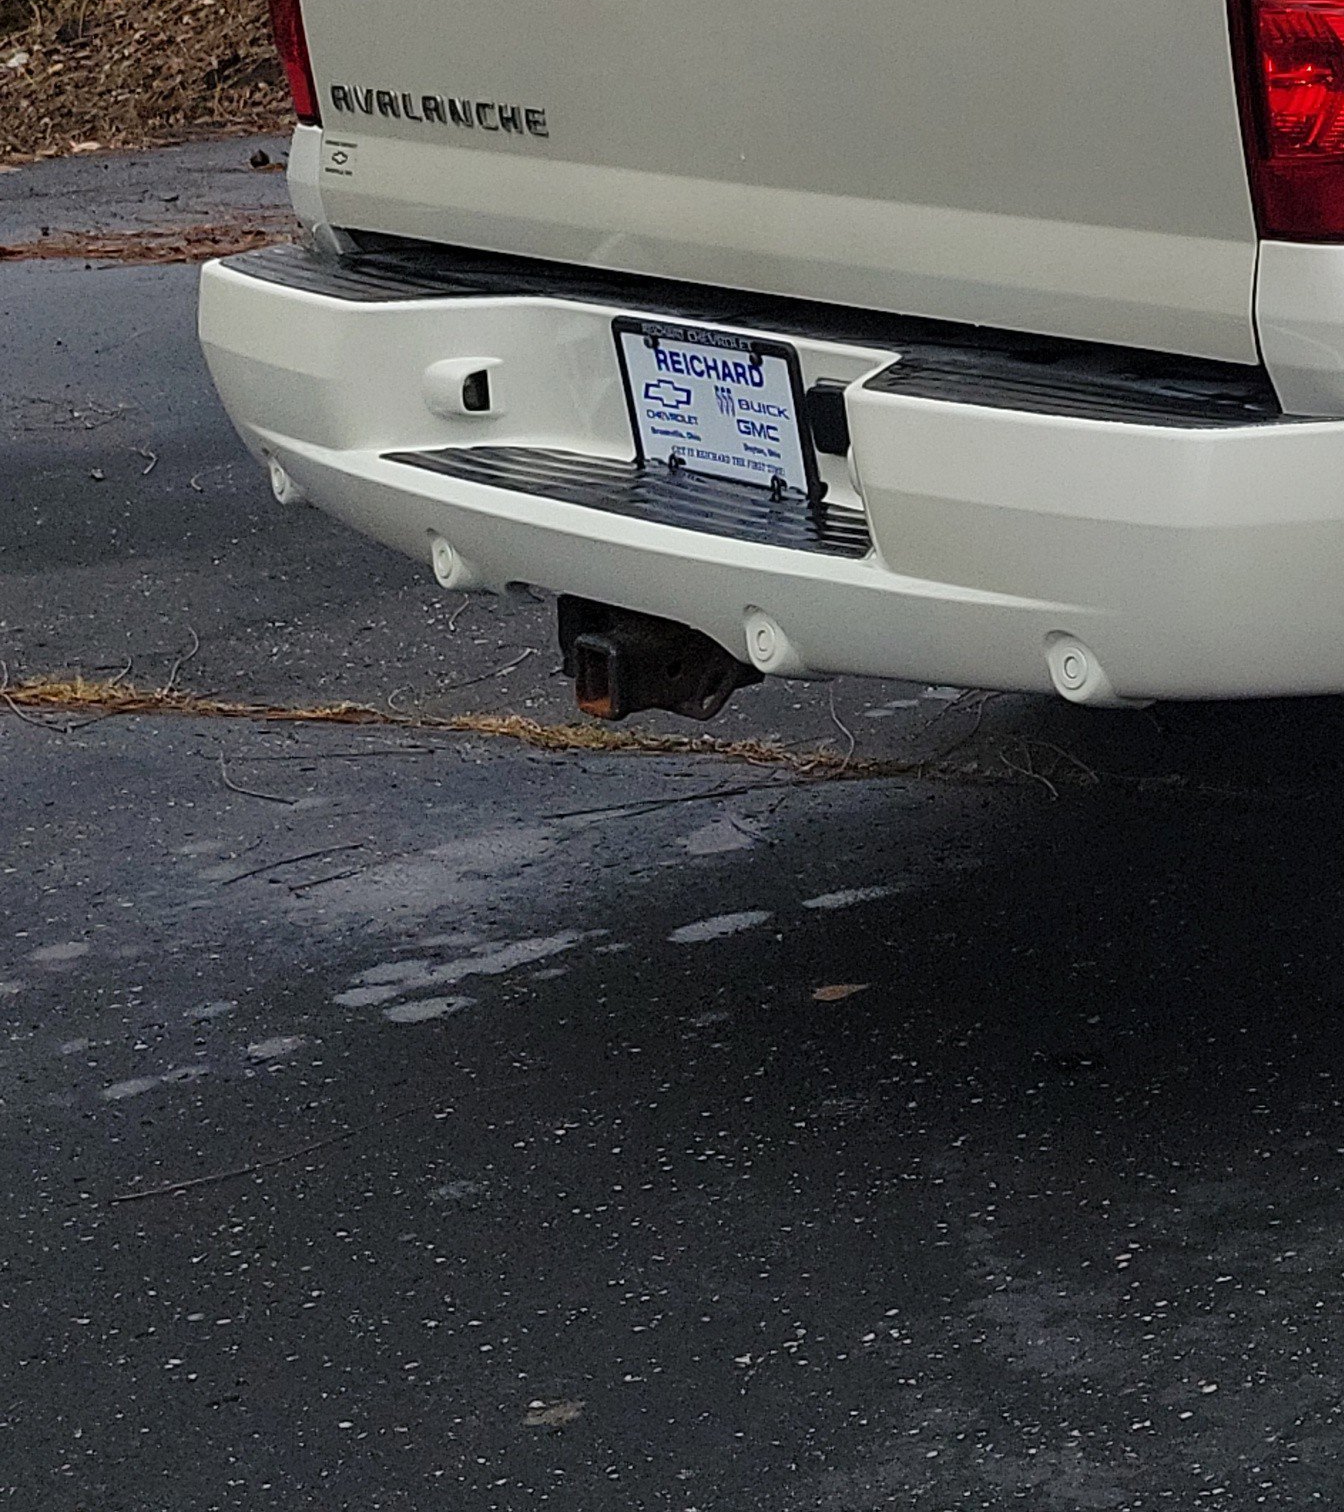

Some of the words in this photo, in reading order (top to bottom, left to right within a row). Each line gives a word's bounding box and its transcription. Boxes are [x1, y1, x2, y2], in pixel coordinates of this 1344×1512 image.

[330, 84, 549, 138] AVALANCHE
[655, 347, 764, 388] REICHARD
[646, 408, 699, 426] CHEVROLET
[737, 398, 790, 420] BUICK
[736, 419, 781, 442] GMC
